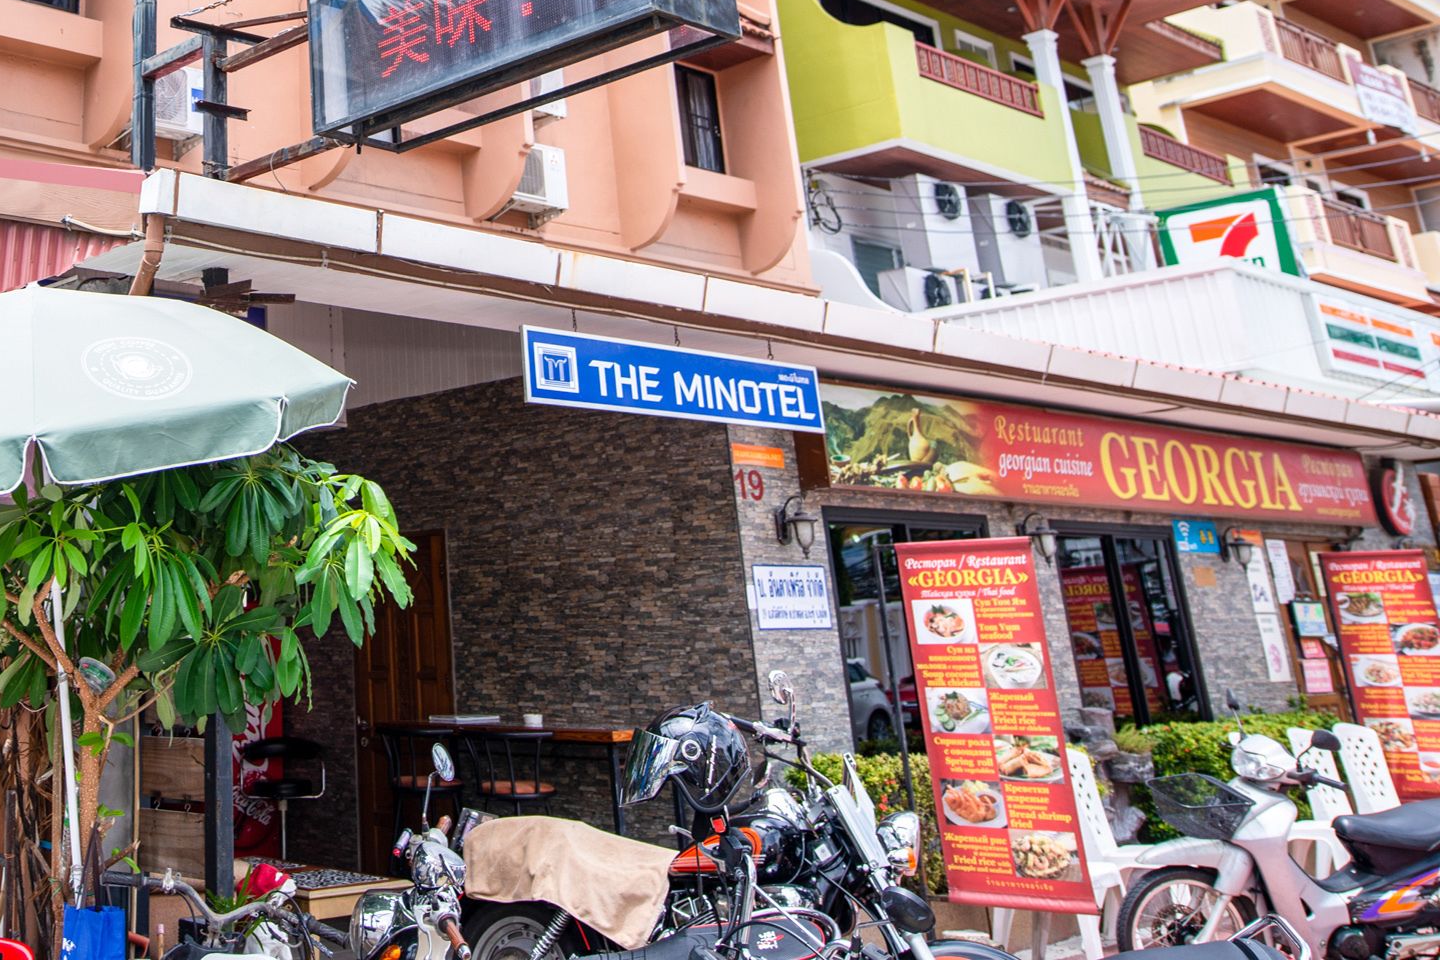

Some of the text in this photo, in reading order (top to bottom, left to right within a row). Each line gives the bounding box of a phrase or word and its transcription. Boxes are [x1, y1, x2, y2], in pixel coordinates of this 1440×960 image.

[589, 359, 816, 420] THE MINOTEL
[994, 415, 1085, 448] Restuarant
[999, 449, 1093, 479] georgian cuisine
[1099, 432, 1303, 512] GEORGIA
[734, 468, 765, 502] 19
[905, 558, 957, 571] Ресторан
[966, 554, 1027, 569] Restaurant
[907, 567, 1029, 588] «GEORGIA»
[998, 586, 1016, 598] food
[979, 623, 1021, 631] Tom Yum
[980, 632, 1013, 640] seafood
[922, 670, 979, 679] Soup coconut
[947, 679, 981, 687] chicken
[993, 716, 1036, 724] Fried rice
[977, 758, 994, 766] roll
[1009, 810, 1072, 823] Bread shrimp
[1010, 819, 1033, 829] fried
[954, 855, 978, 864] Fried
[978, 856, 997, 865] rice
